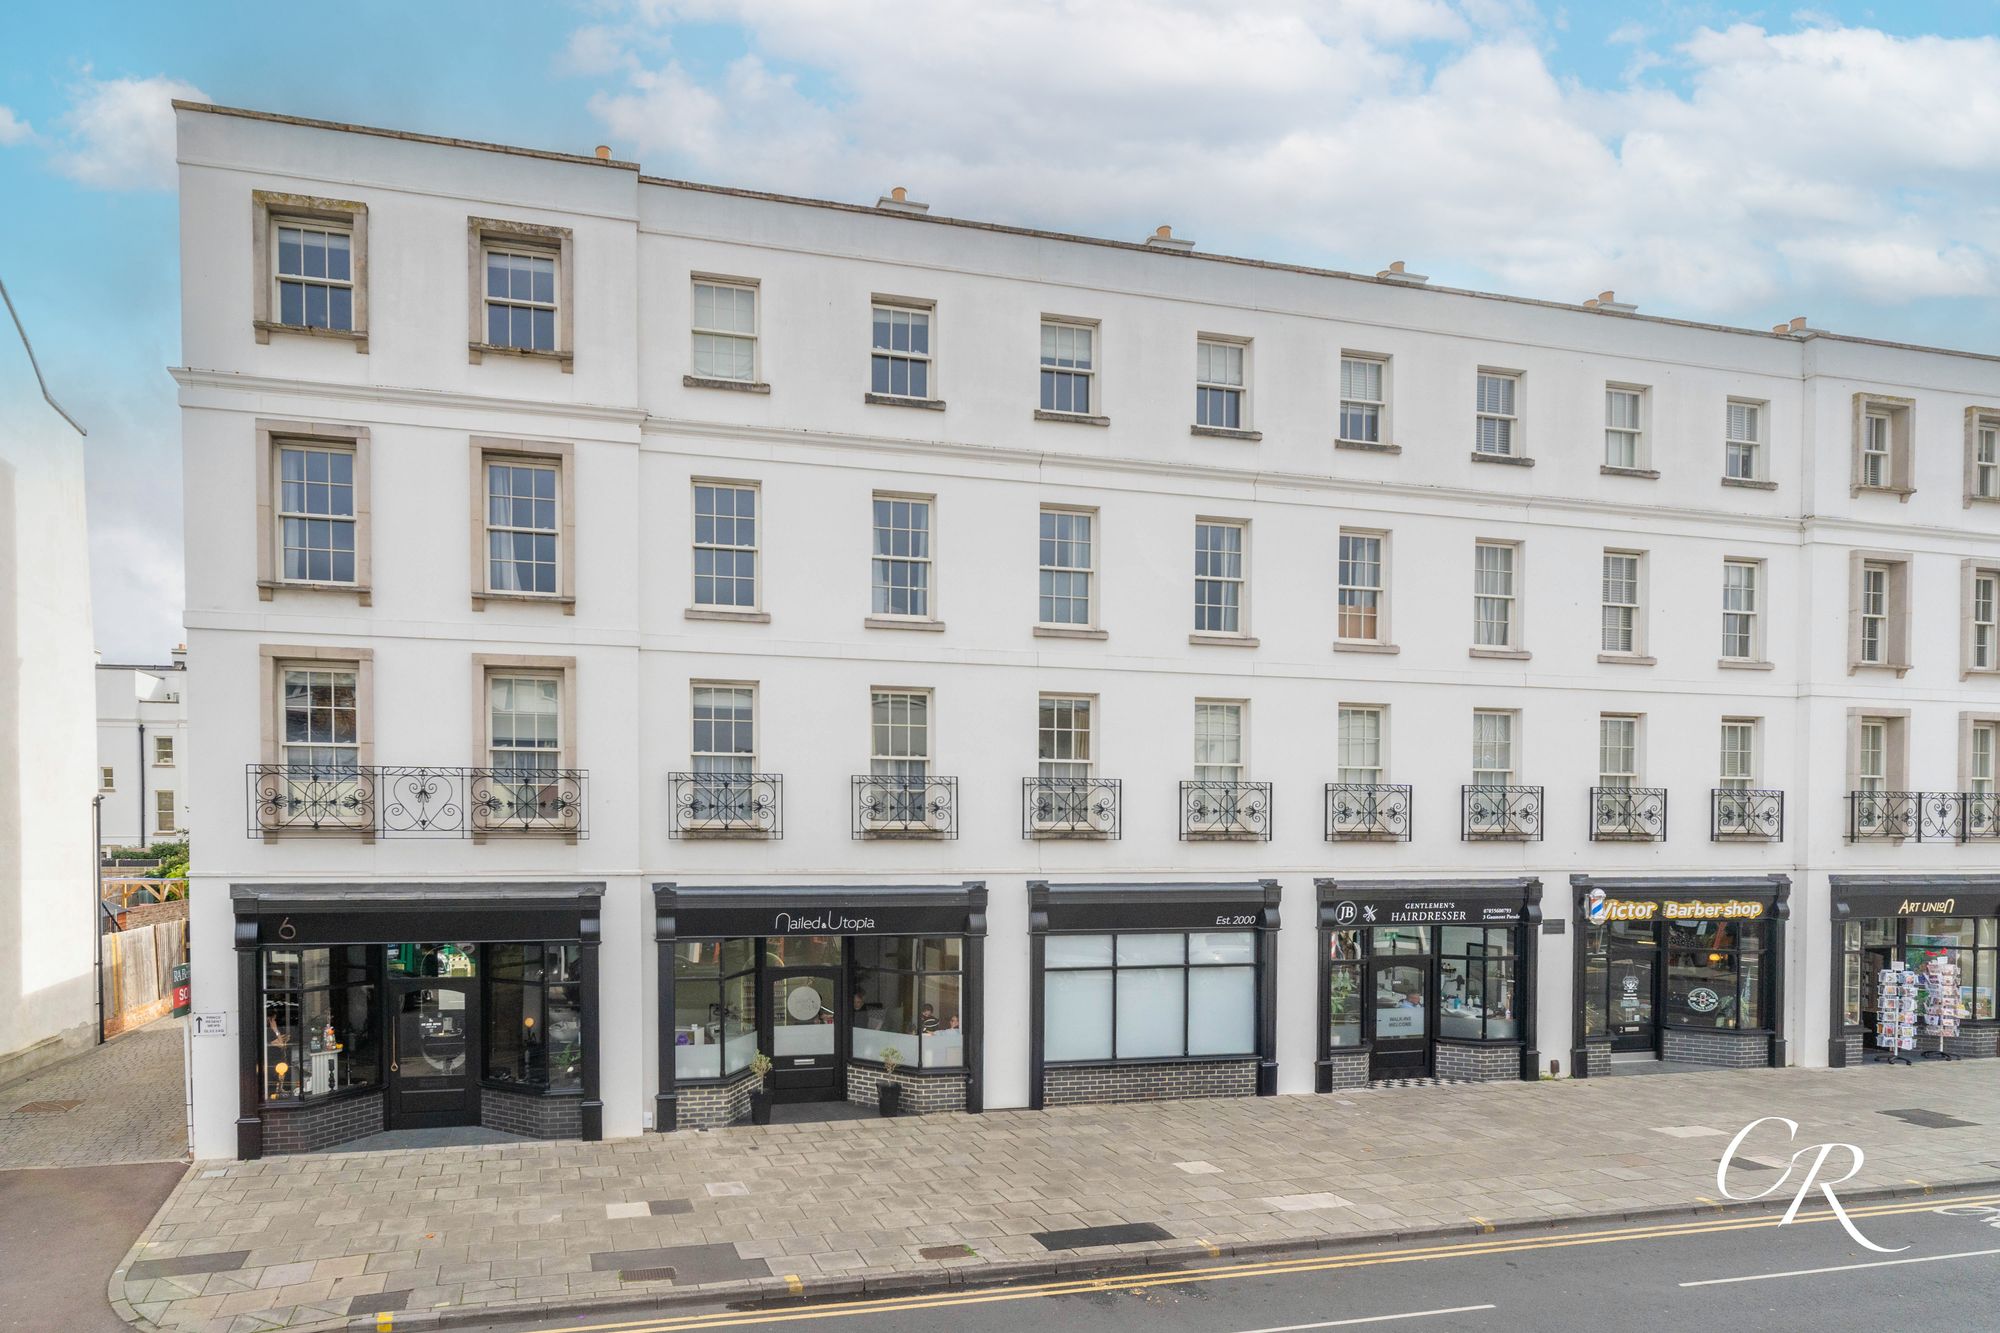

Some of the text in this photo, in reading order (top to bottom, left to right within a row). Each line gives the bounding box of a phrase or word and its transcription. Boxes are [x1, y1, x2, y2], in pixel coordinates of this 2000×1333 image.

[1339, 906, 1354, 920] JB
[1404, 902, 1456, 910] GENTLEMEN'S
[1663, 899, 1721, 919] Barber
[1722, 899, 1763, 919] shop
[775, 912, 821, 932] Nailed
[828, 910, 875, 931] Utopia
[1216, 915, 1256, 925] Est. 2000
[1391, 911, 1467, 922] HAIRDRESSER
[279, 917, 296, 939] 6
